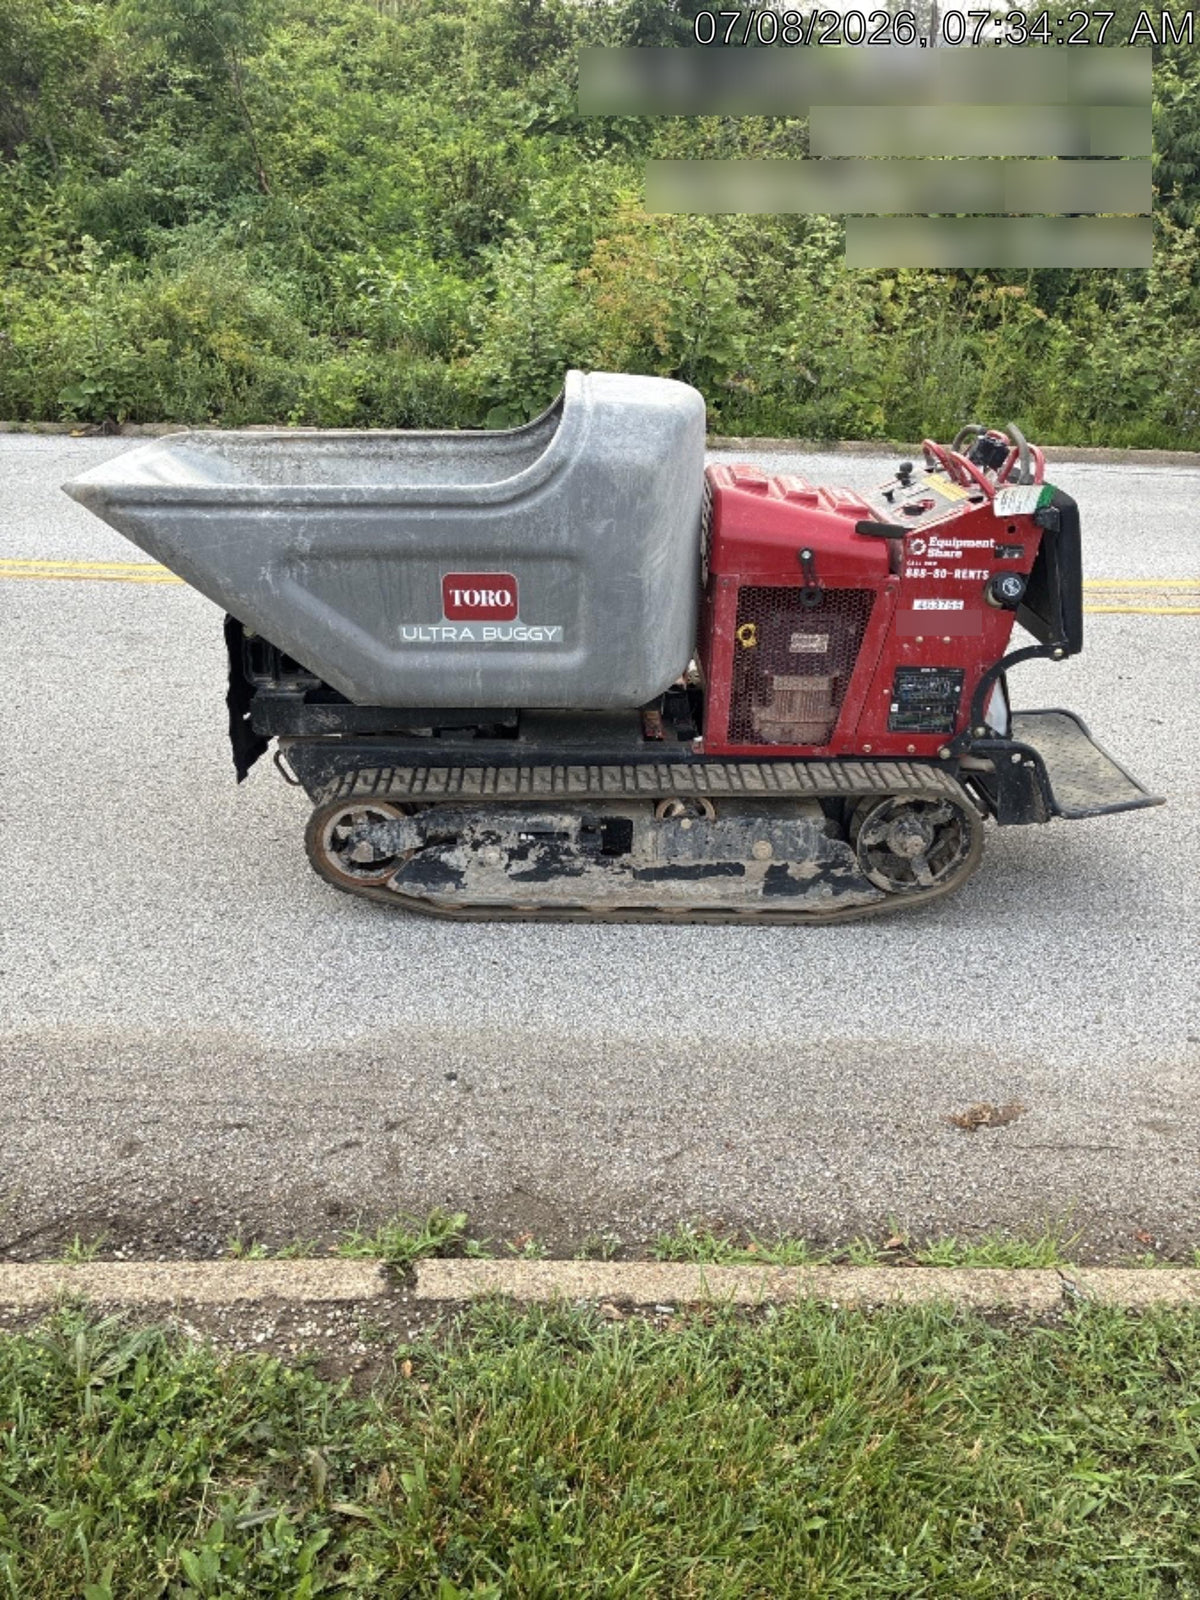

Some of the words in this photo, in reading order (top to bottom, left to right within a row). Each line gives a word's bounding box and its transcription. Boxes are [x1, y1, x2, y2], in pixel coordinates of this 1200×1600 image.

[928, 536, 996, 550] Equipment
[927, 547, 963, 559] Share
[449, 589, 512, 608] TORO
[402, 626, 475, 641] ULTRA
[482, 626, 562, 642] BUGGY
